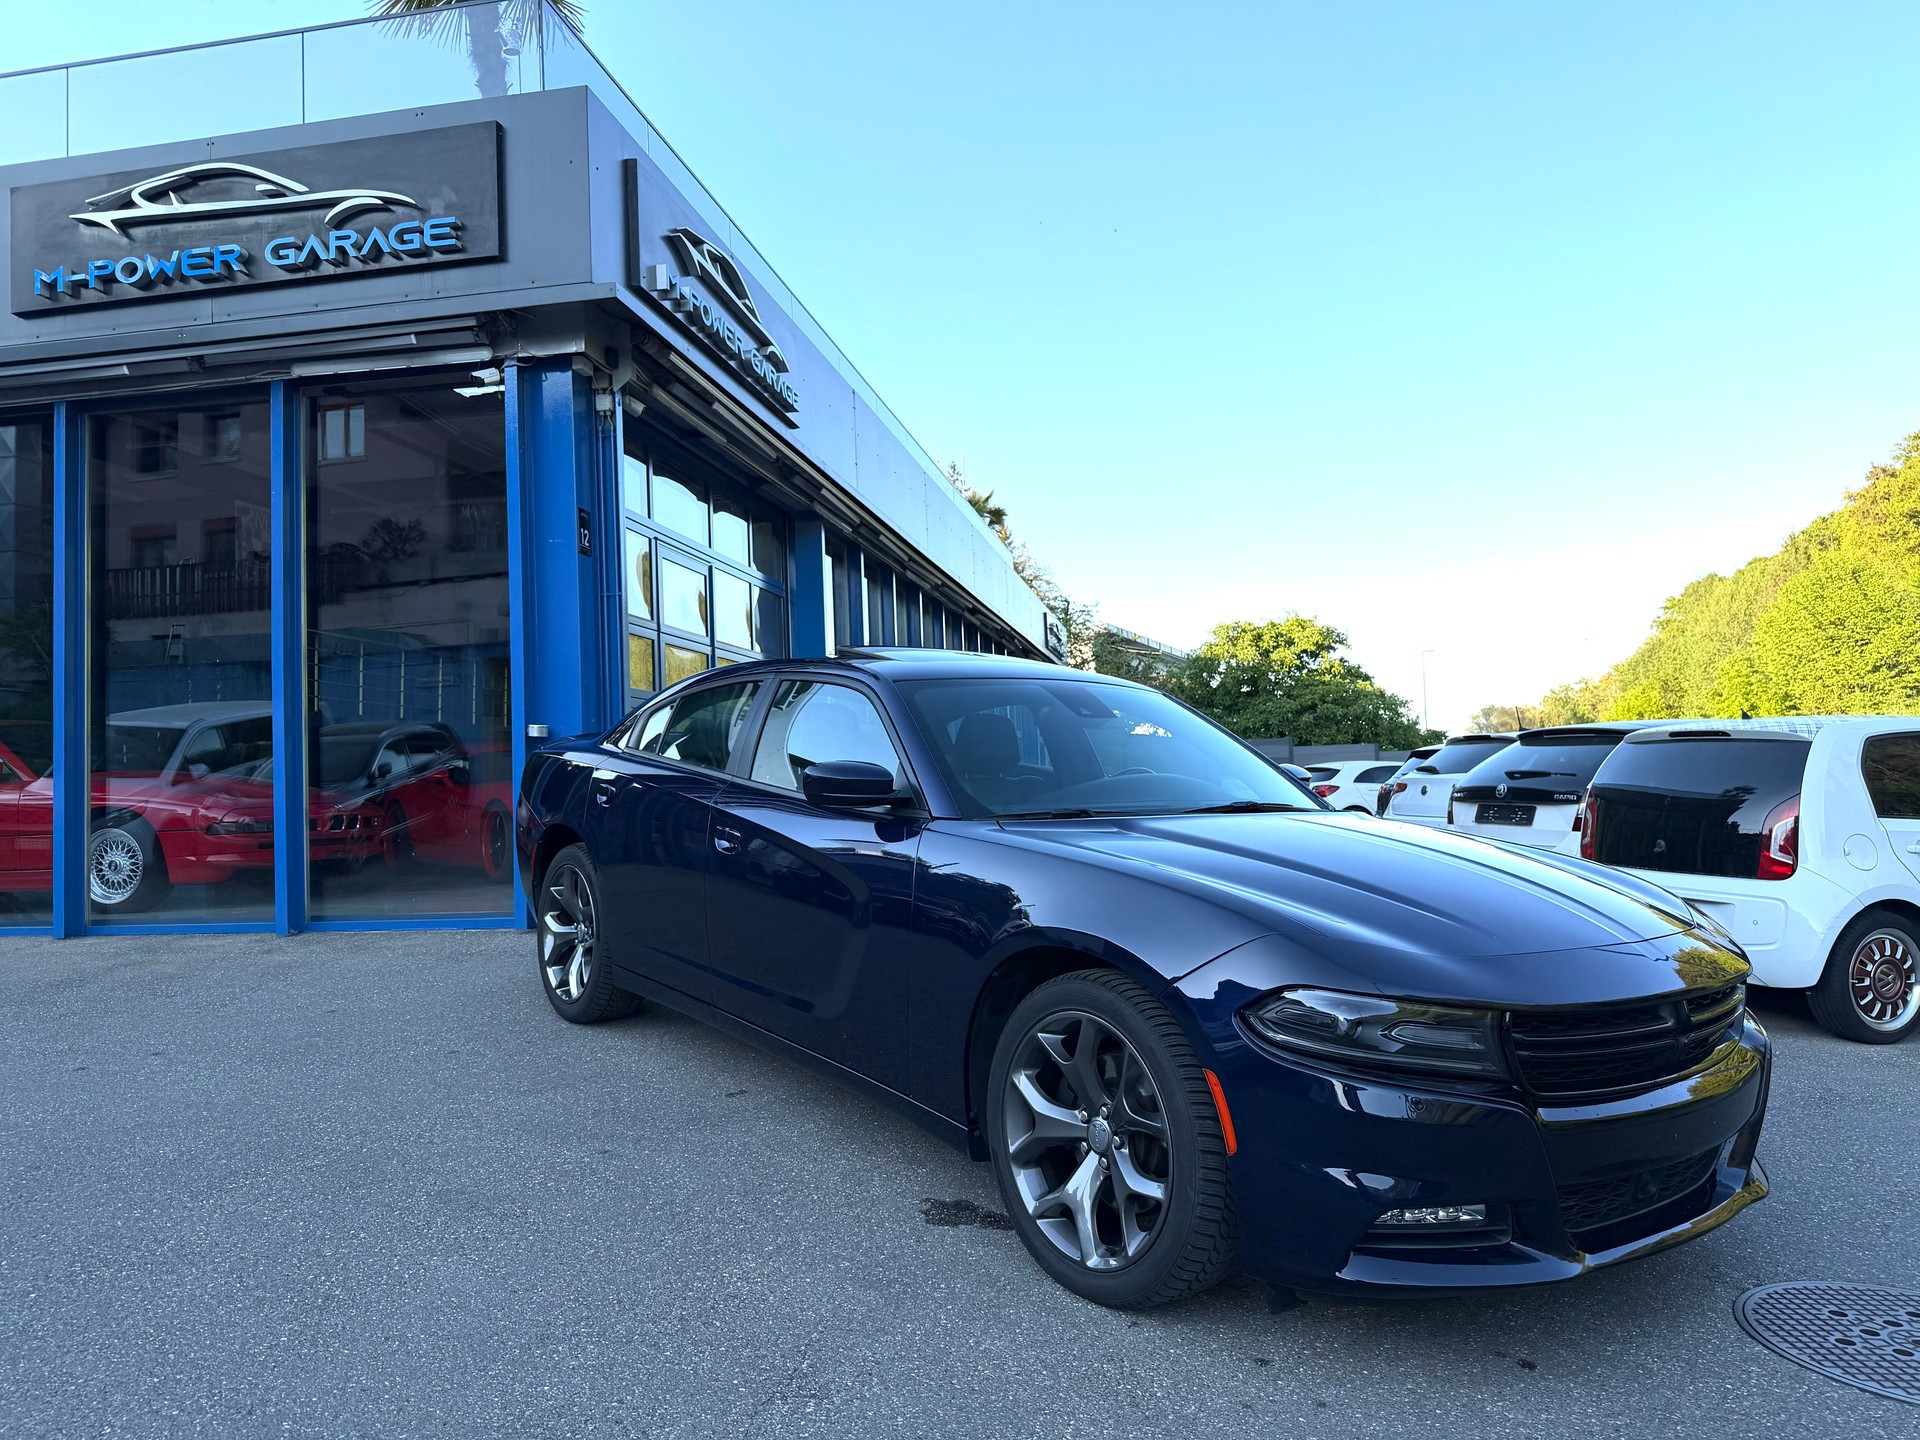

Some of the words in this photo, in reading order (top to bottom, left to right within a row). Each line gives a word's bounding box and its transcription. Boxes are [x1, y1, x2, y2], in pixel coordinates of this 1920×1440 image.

[34, 243, 242, 296] M-POWER
[264, 215, 458, 266] GARAGE
[667, 272, 745, 360] M-POWER
[750, 349, 800, 406] GARAGE
[580, 528, 590, 547] 12
[1553, 793, 1578, 801] RAPID
